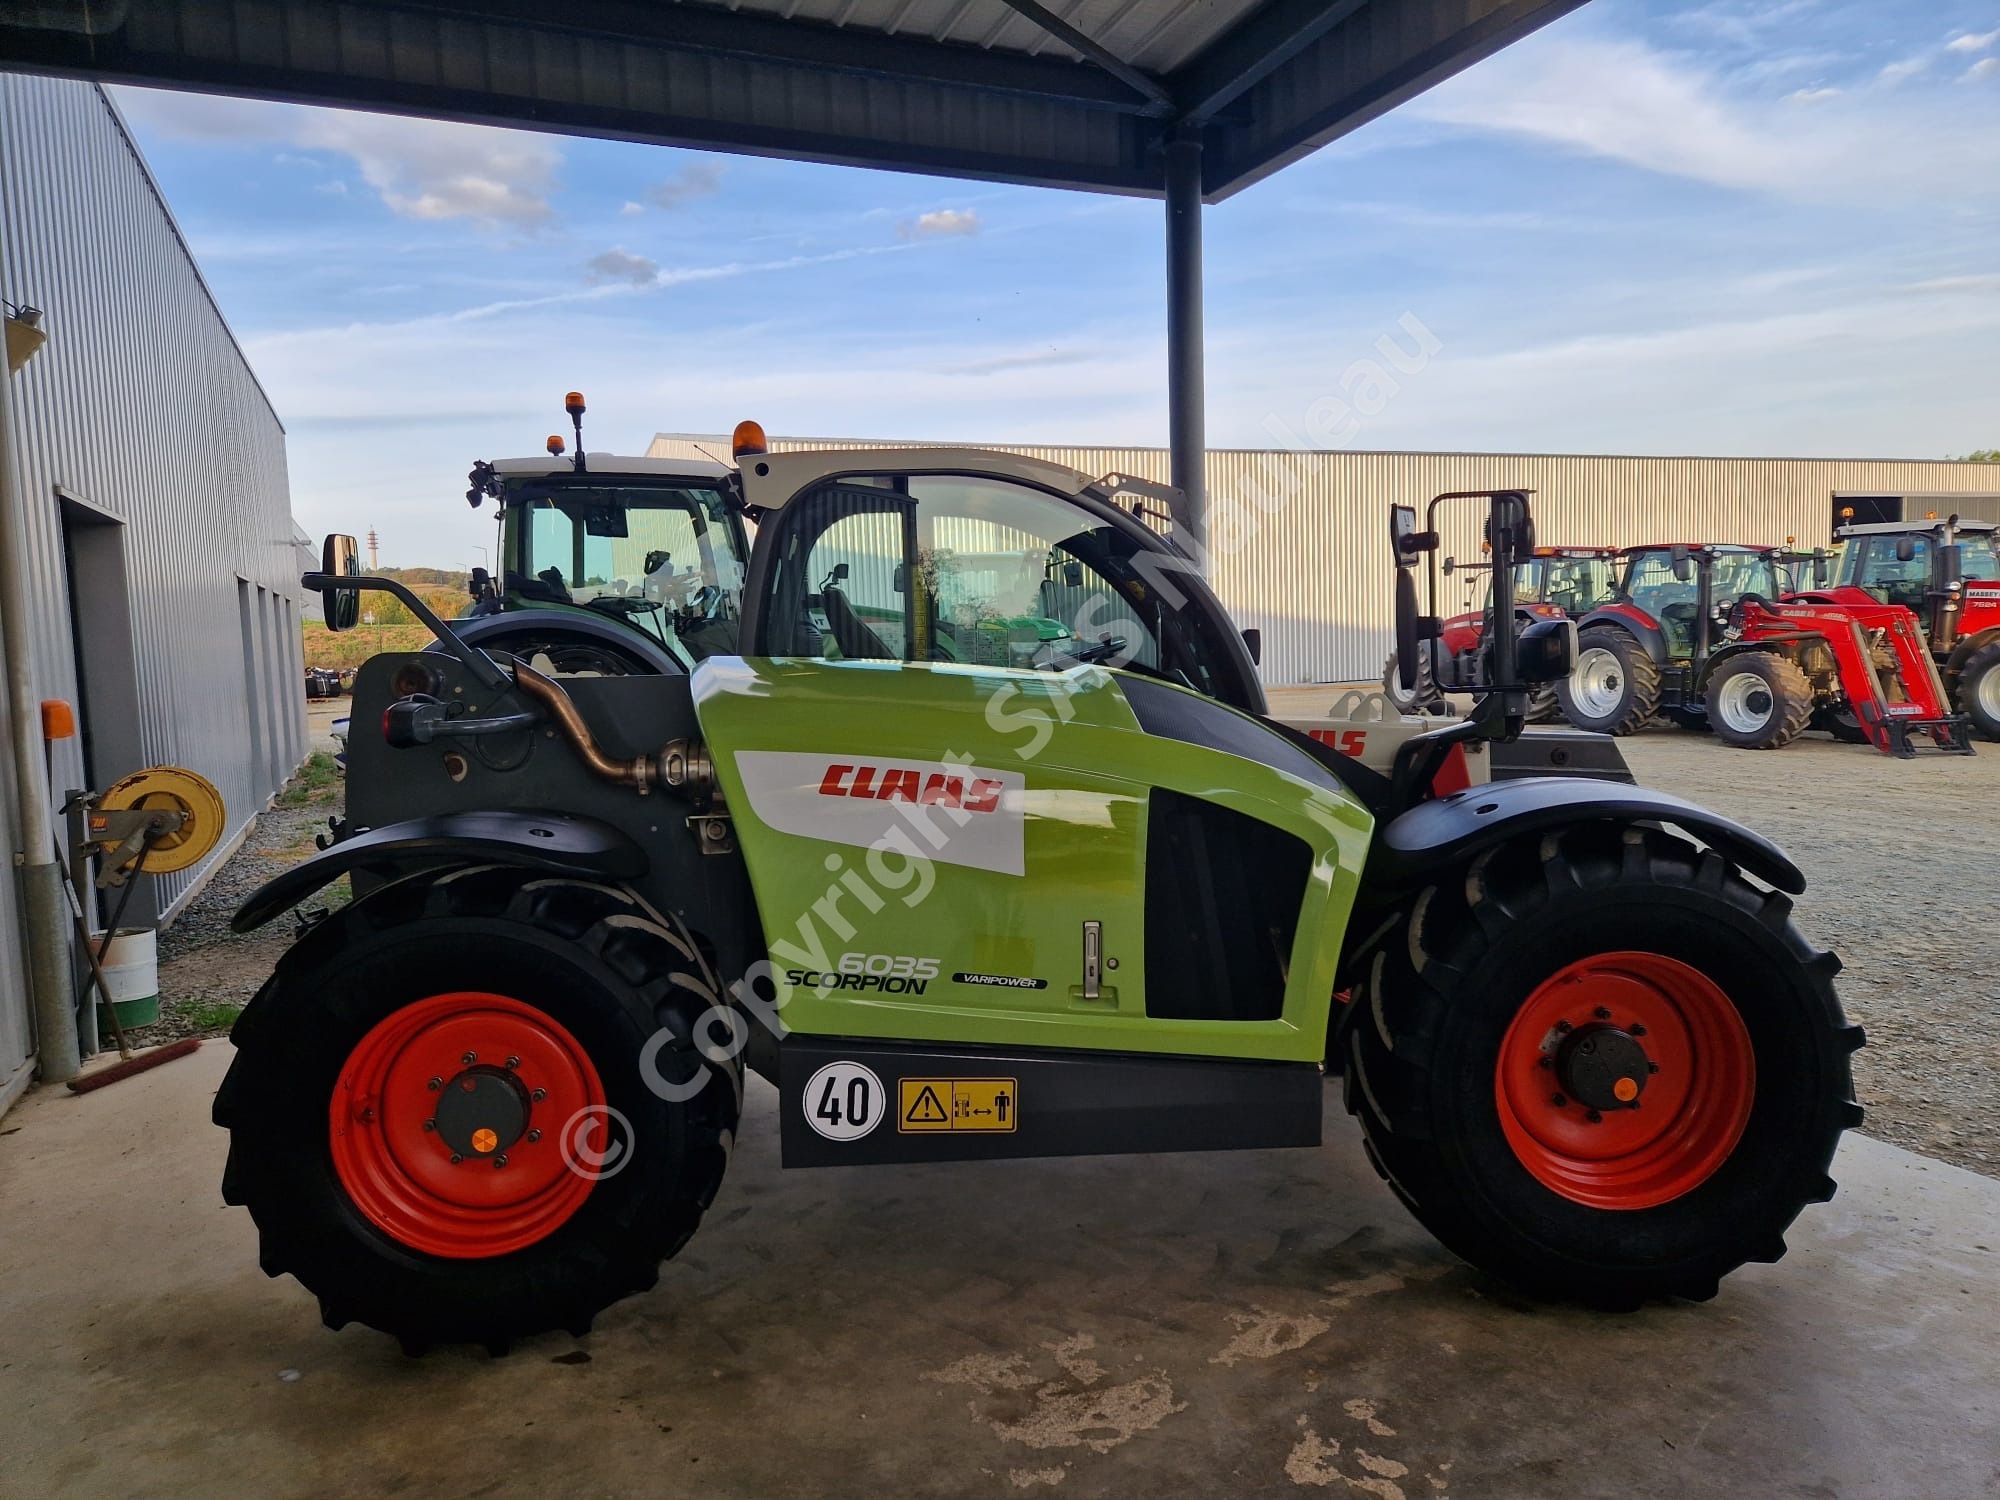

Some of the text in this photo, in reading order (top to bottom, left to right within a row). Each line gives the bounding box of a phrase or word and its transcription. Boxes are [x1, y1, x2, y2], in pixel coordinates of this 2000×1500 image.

[818, 764, 1004, 813] CLAAS
[837, 952, 941, 980] 6035
[784, 969, 928, 995] SCORPION
[963, 973, 1038, 988] VARIPOWER
[816, 1076, 870, 1127] 40
